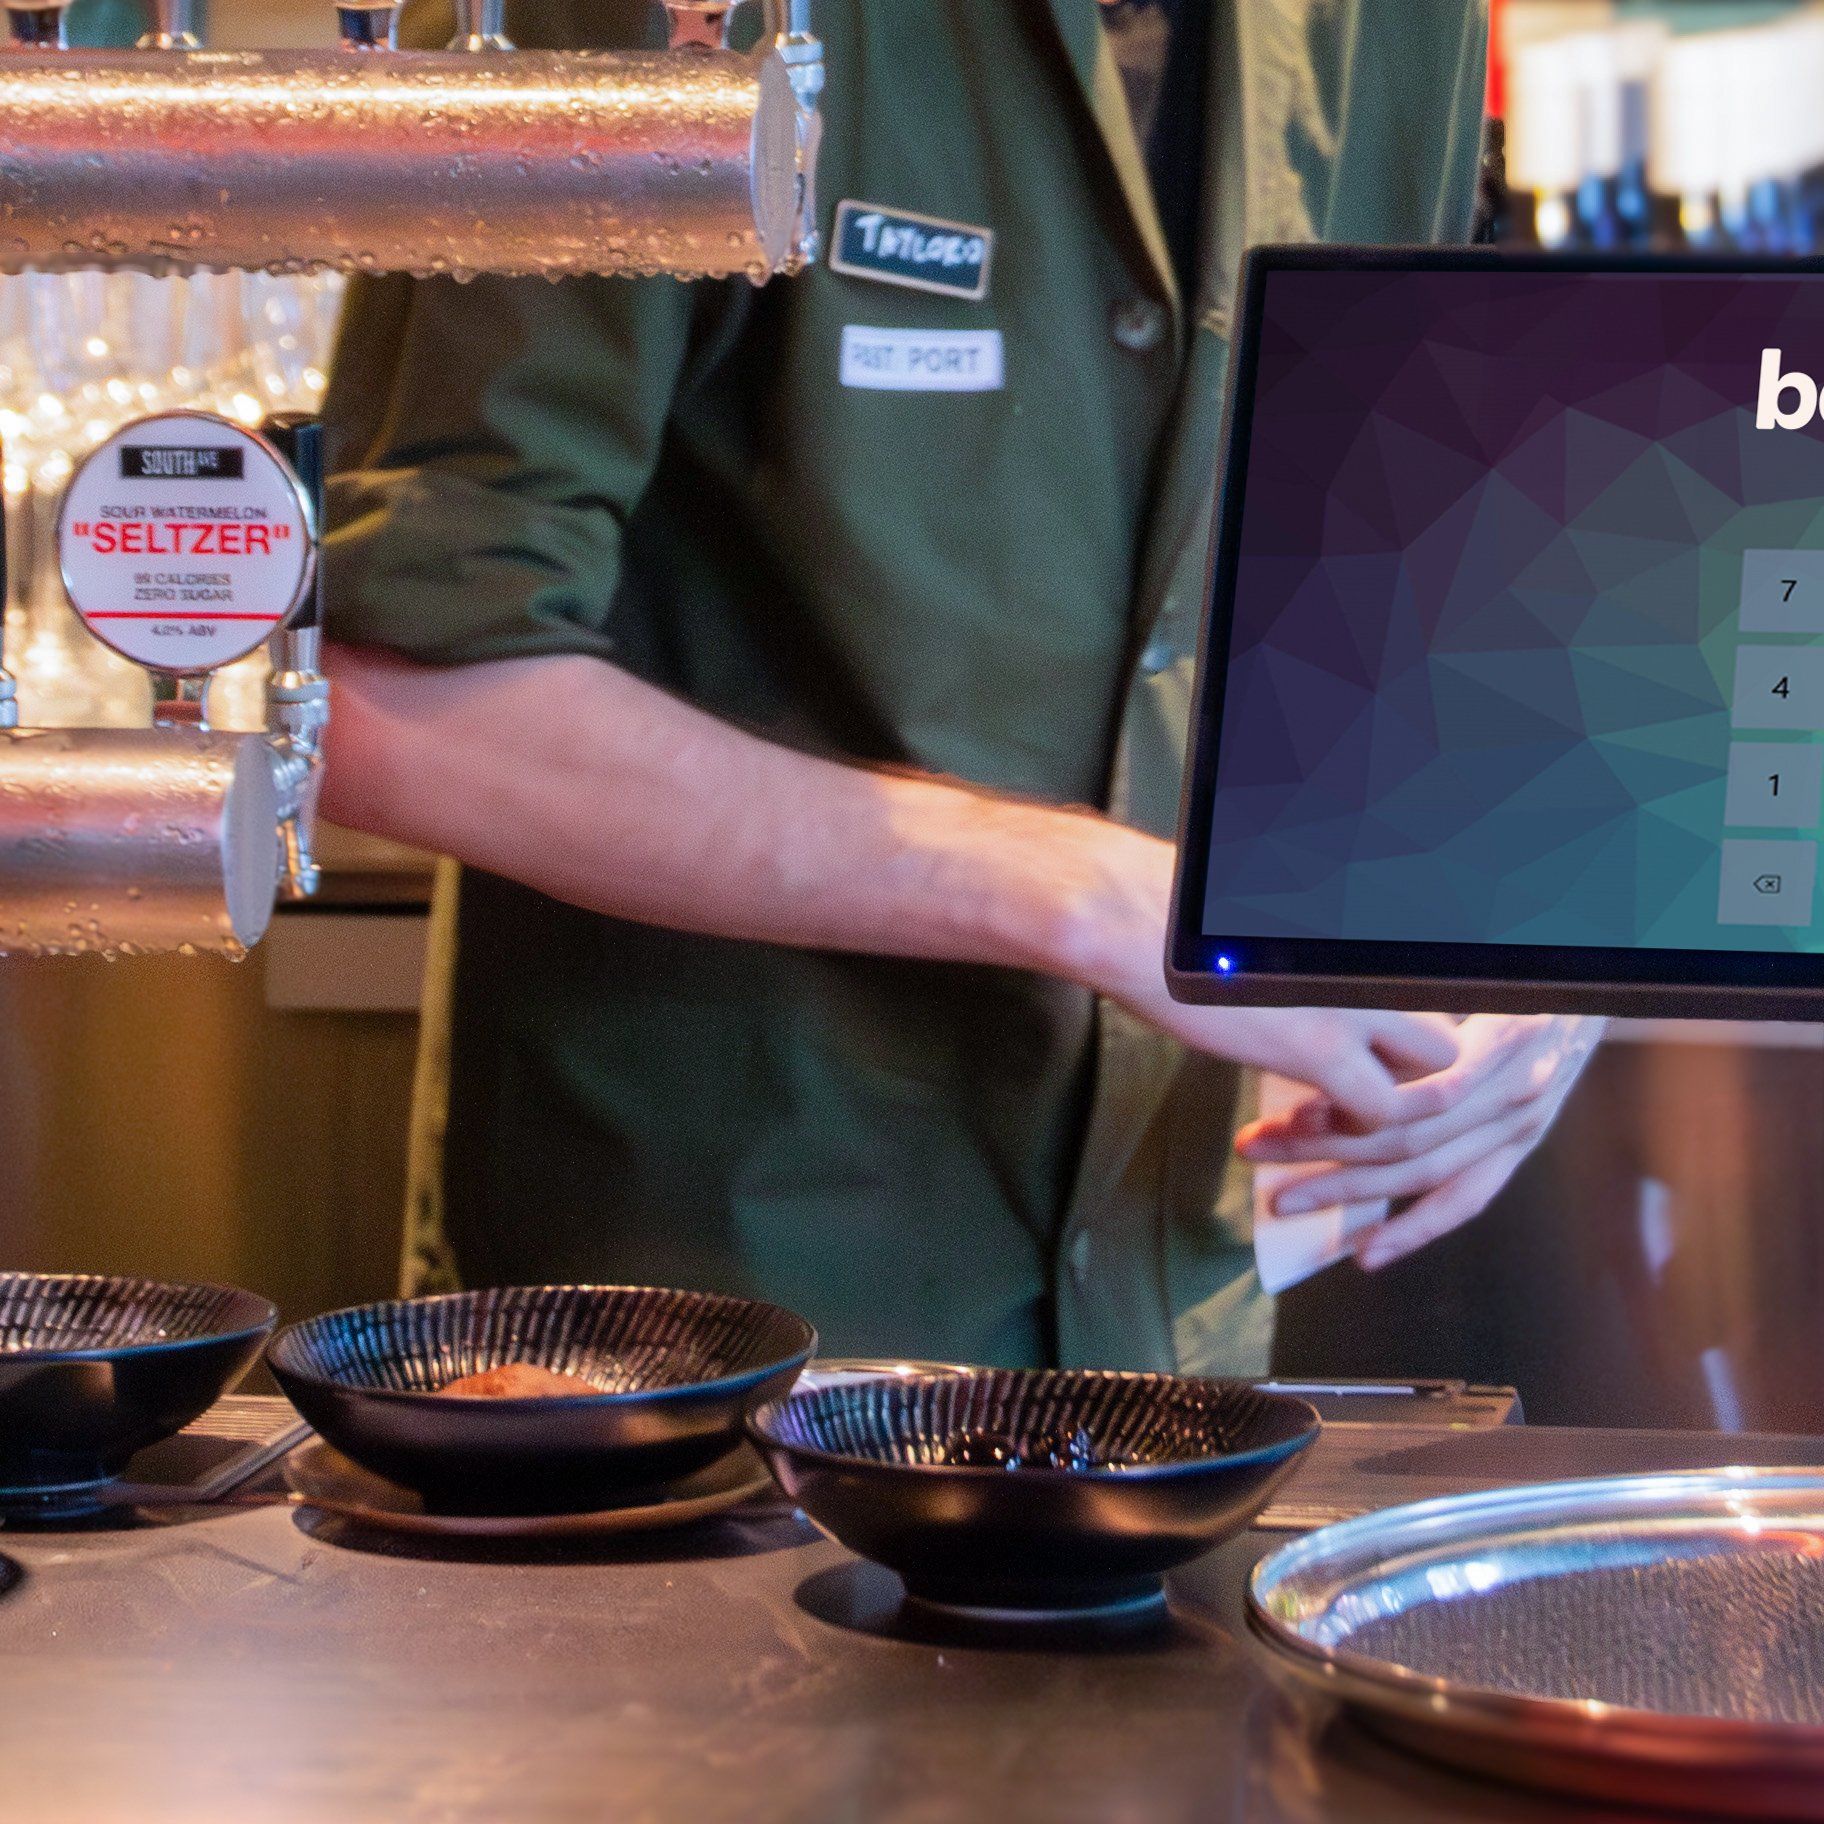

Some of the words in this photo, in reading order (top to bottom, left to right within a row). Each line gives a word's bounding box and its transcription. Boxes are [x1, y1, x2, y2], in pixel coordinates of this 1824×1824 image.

[141, 451, 198, 475] SOUTH
[1781, 580, 1797, 602] 7
[1771, 677, 1789, 699] 4
[1768, 774, 1778, 796] 1
